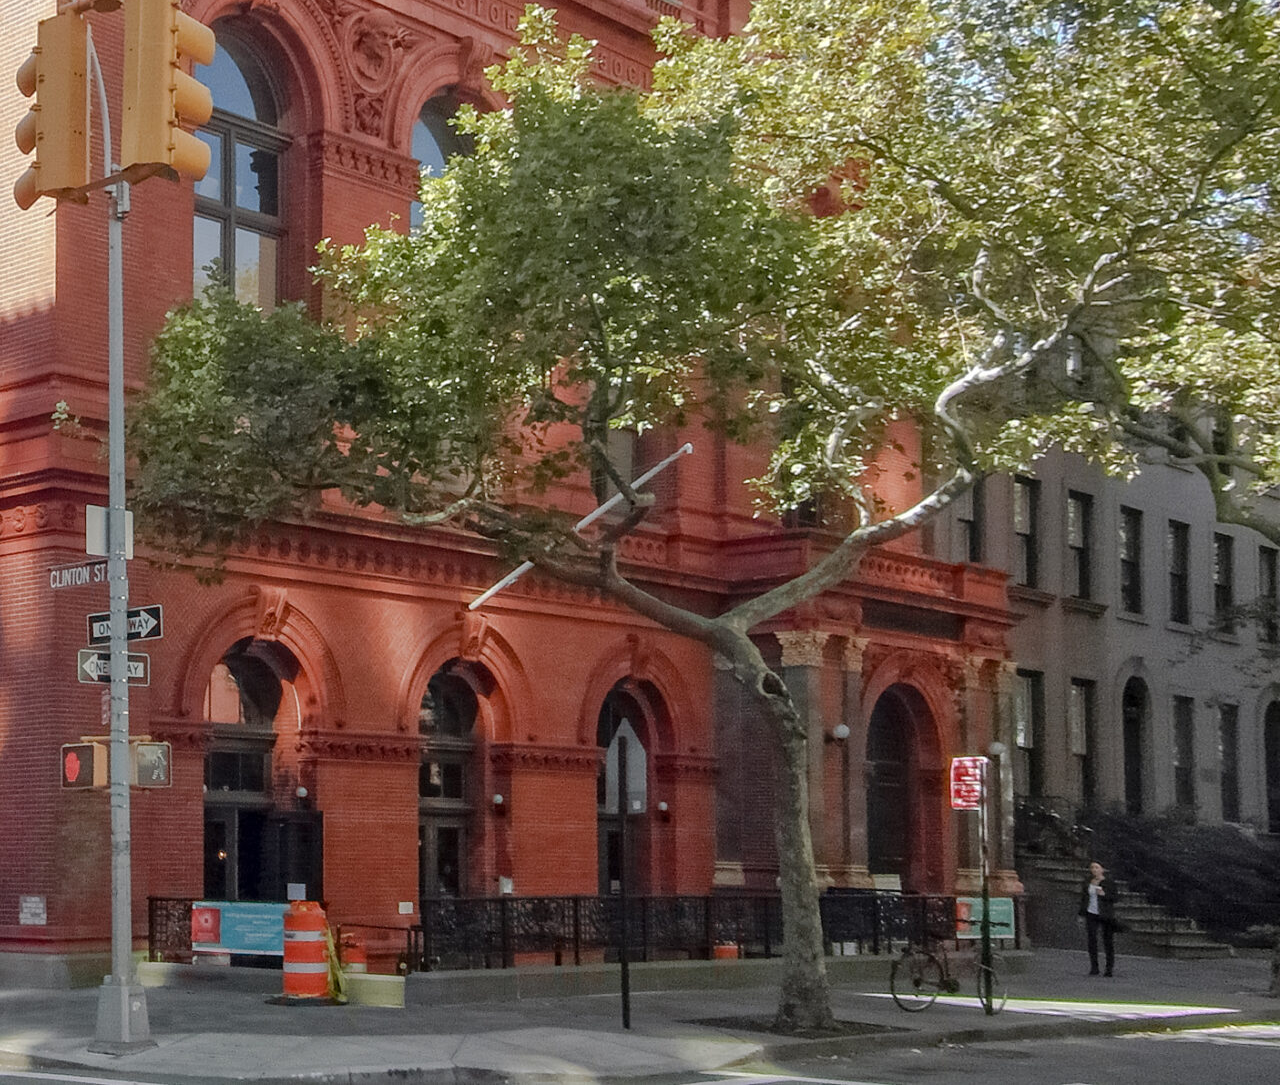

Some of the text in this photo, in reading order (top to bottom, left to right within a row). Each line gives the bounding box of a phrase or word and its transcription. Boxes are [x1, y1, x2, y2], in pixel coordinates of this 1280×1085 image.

[50, 564, 106, 588] CLINTON ST
[98, 618, 150, 635] ON WAY
[89, 661, 139, 675] ONE AY
